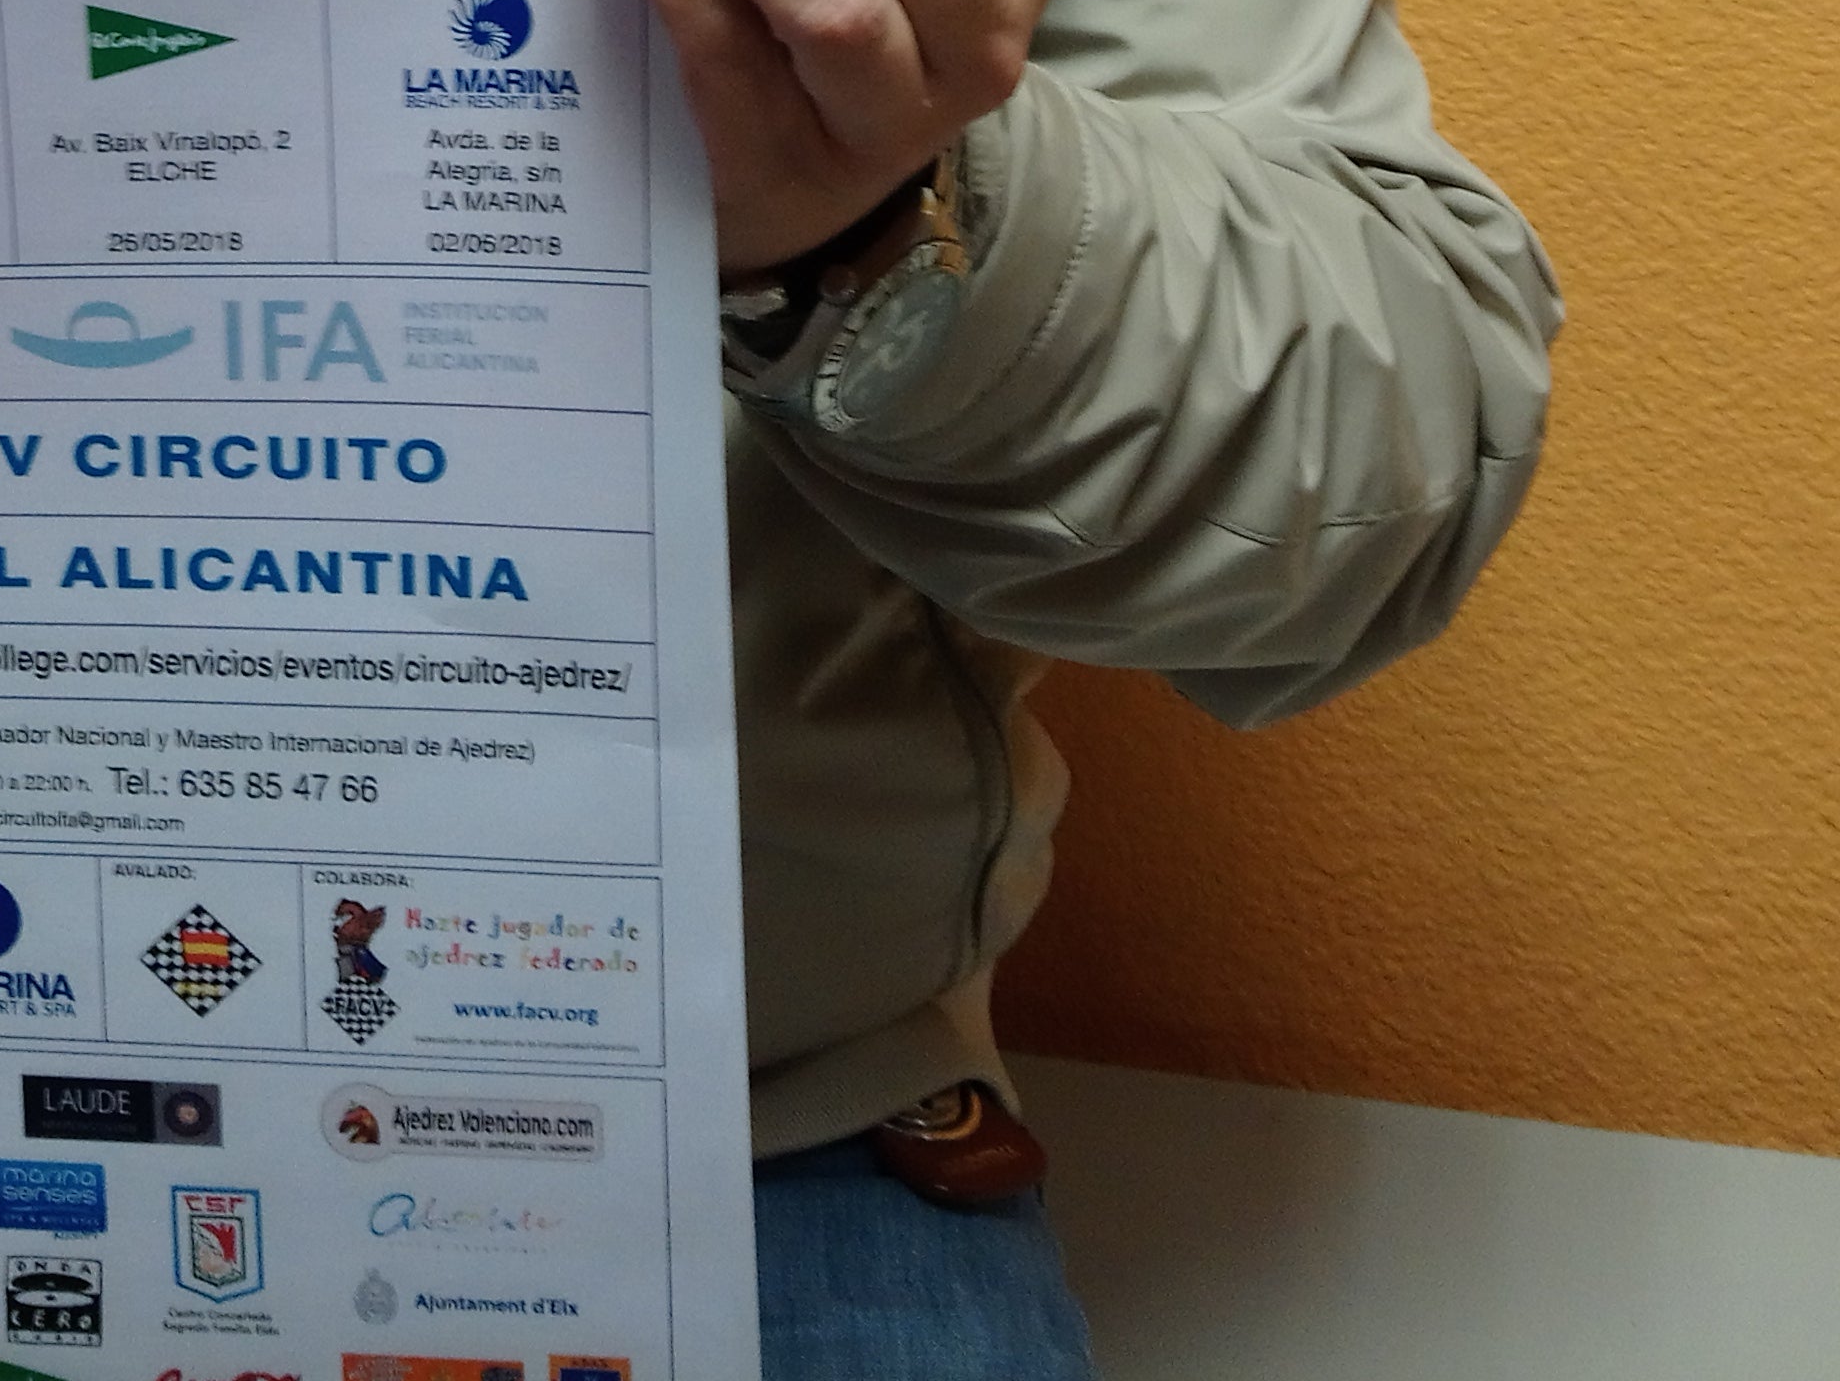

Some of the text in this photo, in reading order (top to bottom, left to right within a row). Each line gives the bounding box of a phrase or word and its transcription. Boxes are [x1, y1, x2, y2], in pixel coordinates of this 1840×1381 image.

[404, 69, 580, 95] LA MARINA
[52, 134, 91, 154] Av.
[97, 134, 149, 153] Baix
[276, 131, 291, 150] 2
[427, 130, 560, 151] Avda. de la
[128, 162, 217, 182] ELCHE
[525, 163, 561, 181] s/n
[423, 192, 567, 214] LA MARINA
[221, 298, 388, 384] IFA
[74, 435, 447, 484] CIRCUITO
[62, 546, 530, 602] ALICANTINA
[58, 725, 149, 747] Nacional
[174, 728, 261, 751] Maestro
[269, 731, 407, 756] Internacional
[416, 737, 442, 757] de
[450, 737, 535, 766] Ajedrez)
[107, 766, 378, 803] Tel.: 635 85 47 66
[488, 913, 594, 940] jugador
[609, 916, 639, 941] de
[43, 1000, 77, 1018] SPA
[42, 1086, 131, 1115] LAUDE
[393, 1105, 455, 1137] Ajedrez
[2, 1185, 98, 1205] senses
[415, 1293, 527, 1315] Ajuntament
[11, 1309, 93, 1329] CERO
